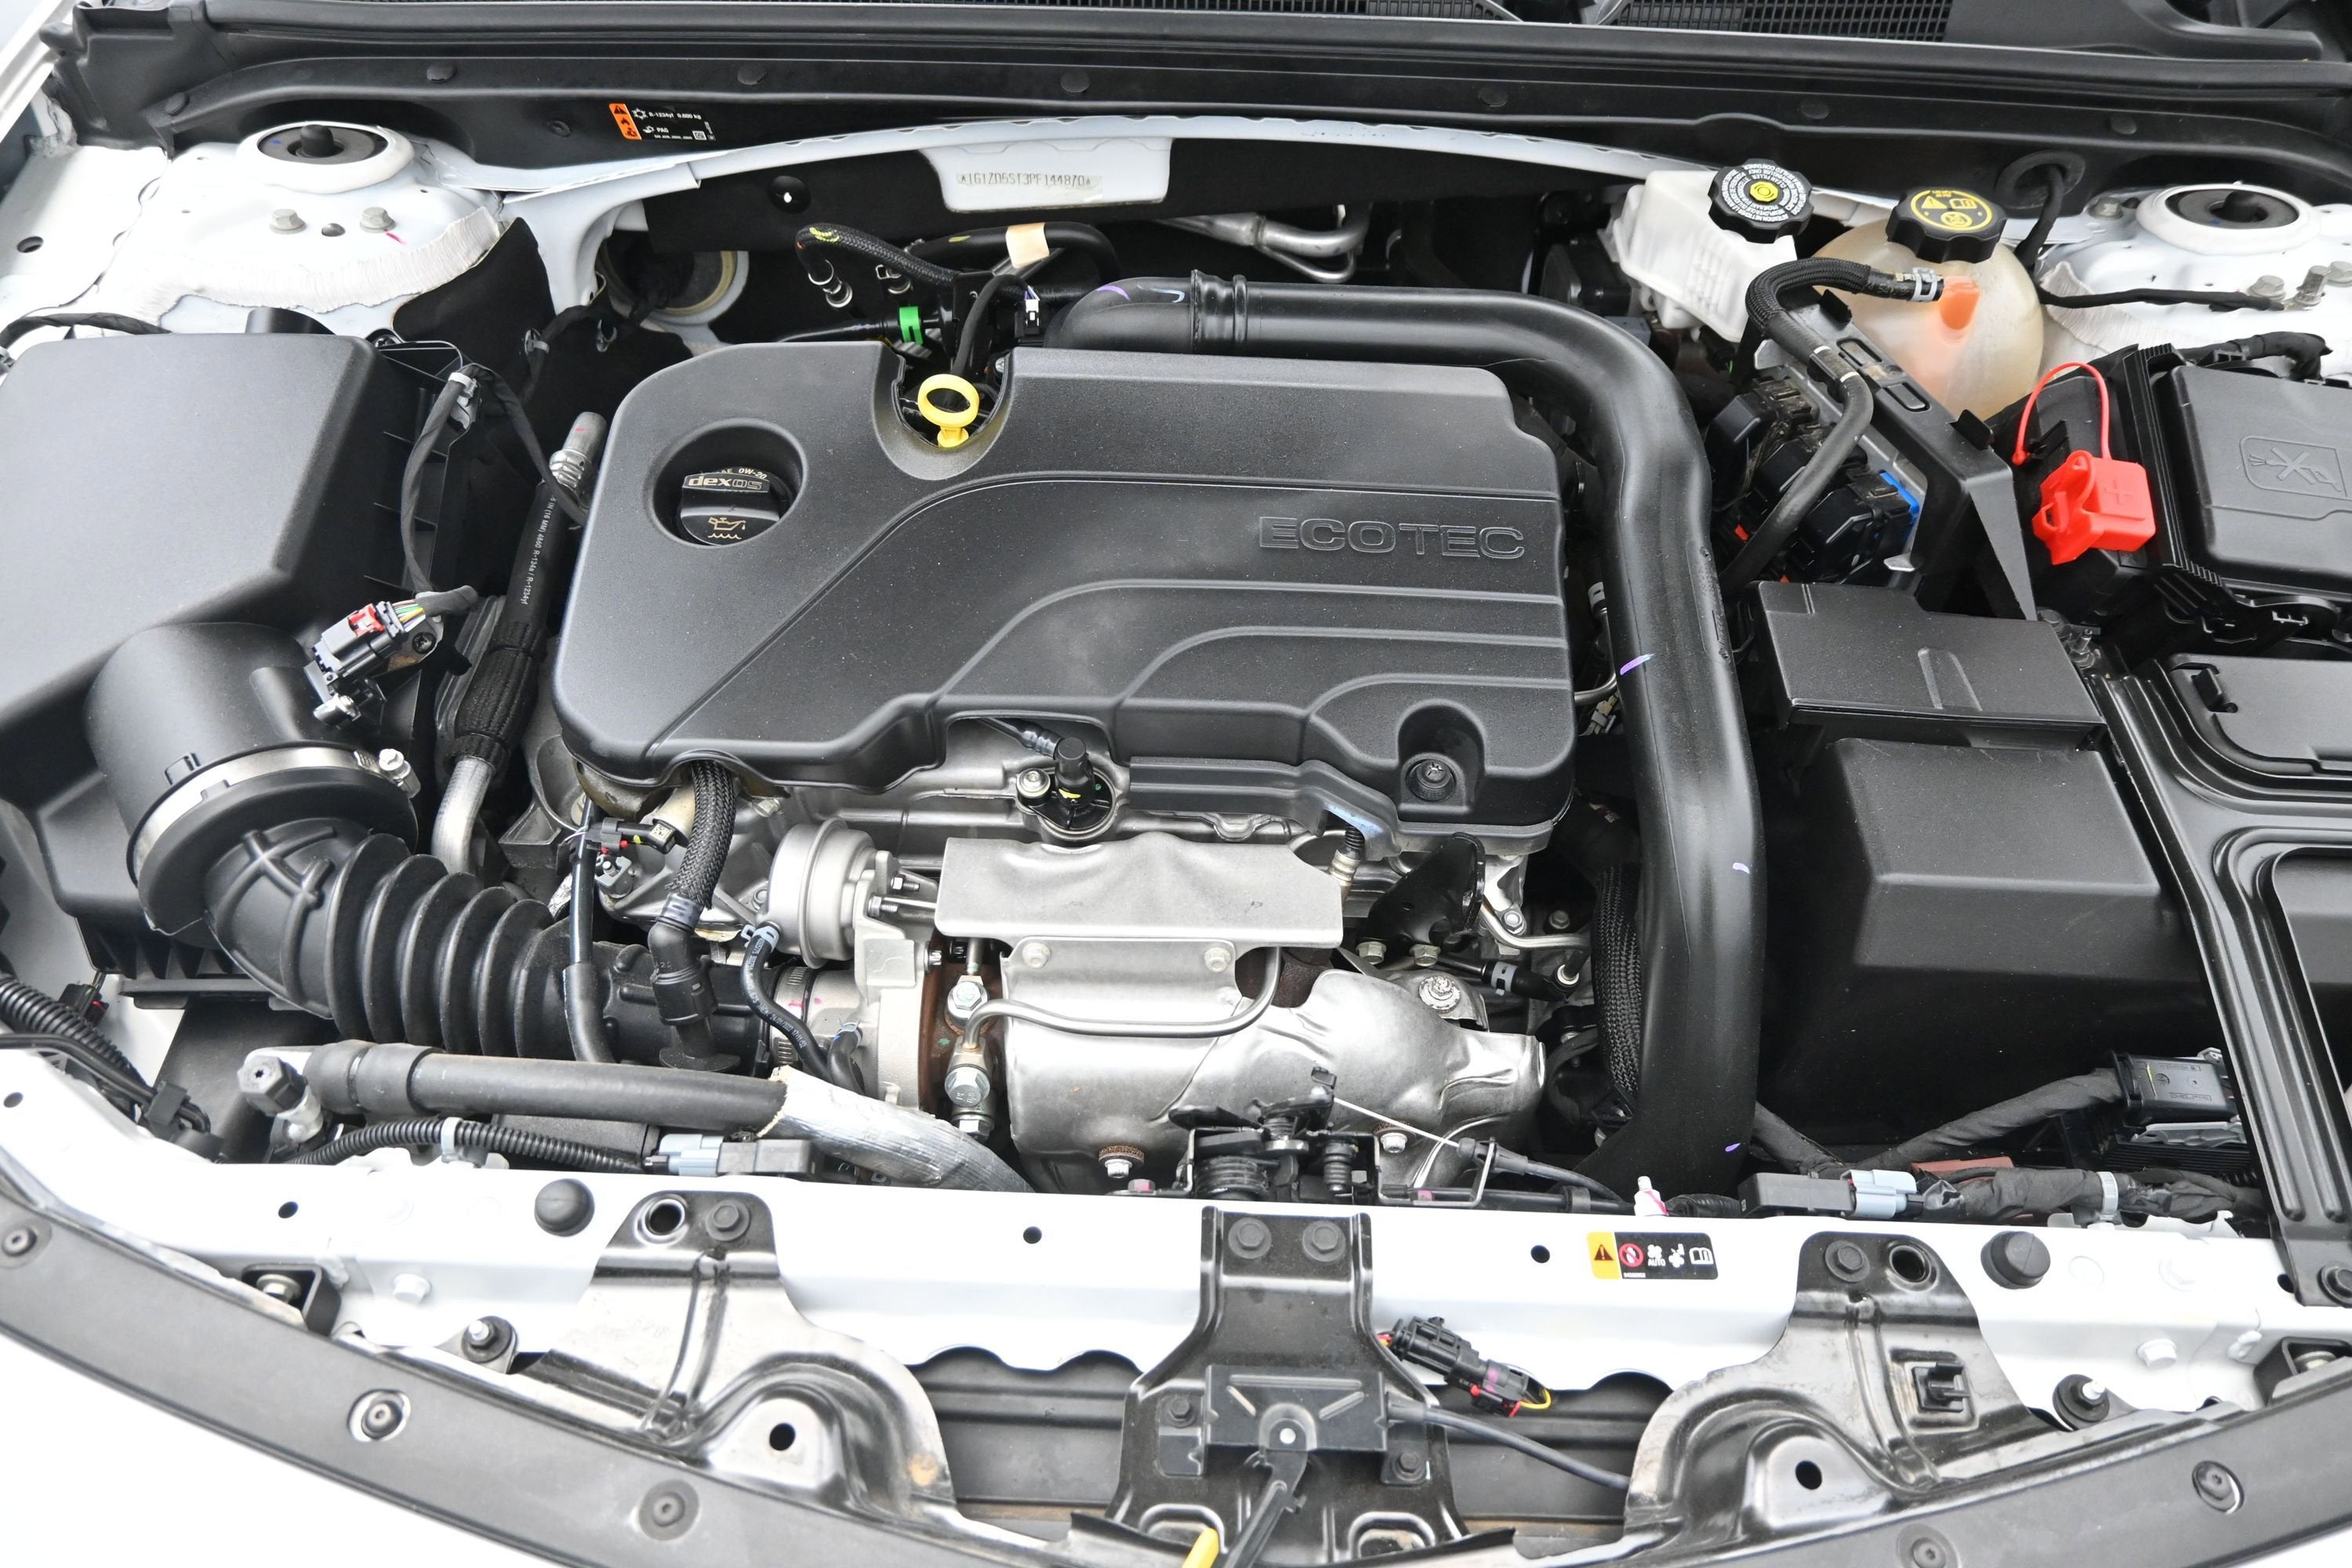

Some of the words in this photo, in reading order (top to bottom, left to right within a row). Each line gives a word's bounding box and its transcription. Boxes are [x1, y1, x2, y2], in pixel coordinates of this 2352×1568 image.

[738, 468, 768, 479] 0W-20
[688, 476, 763, 490] dexos
[1258, 515, 1526, 560] ECOTEC
[521, 576, 534, 605] R-1234yf
[1648, 1258, 1666, 1267] AUTO
